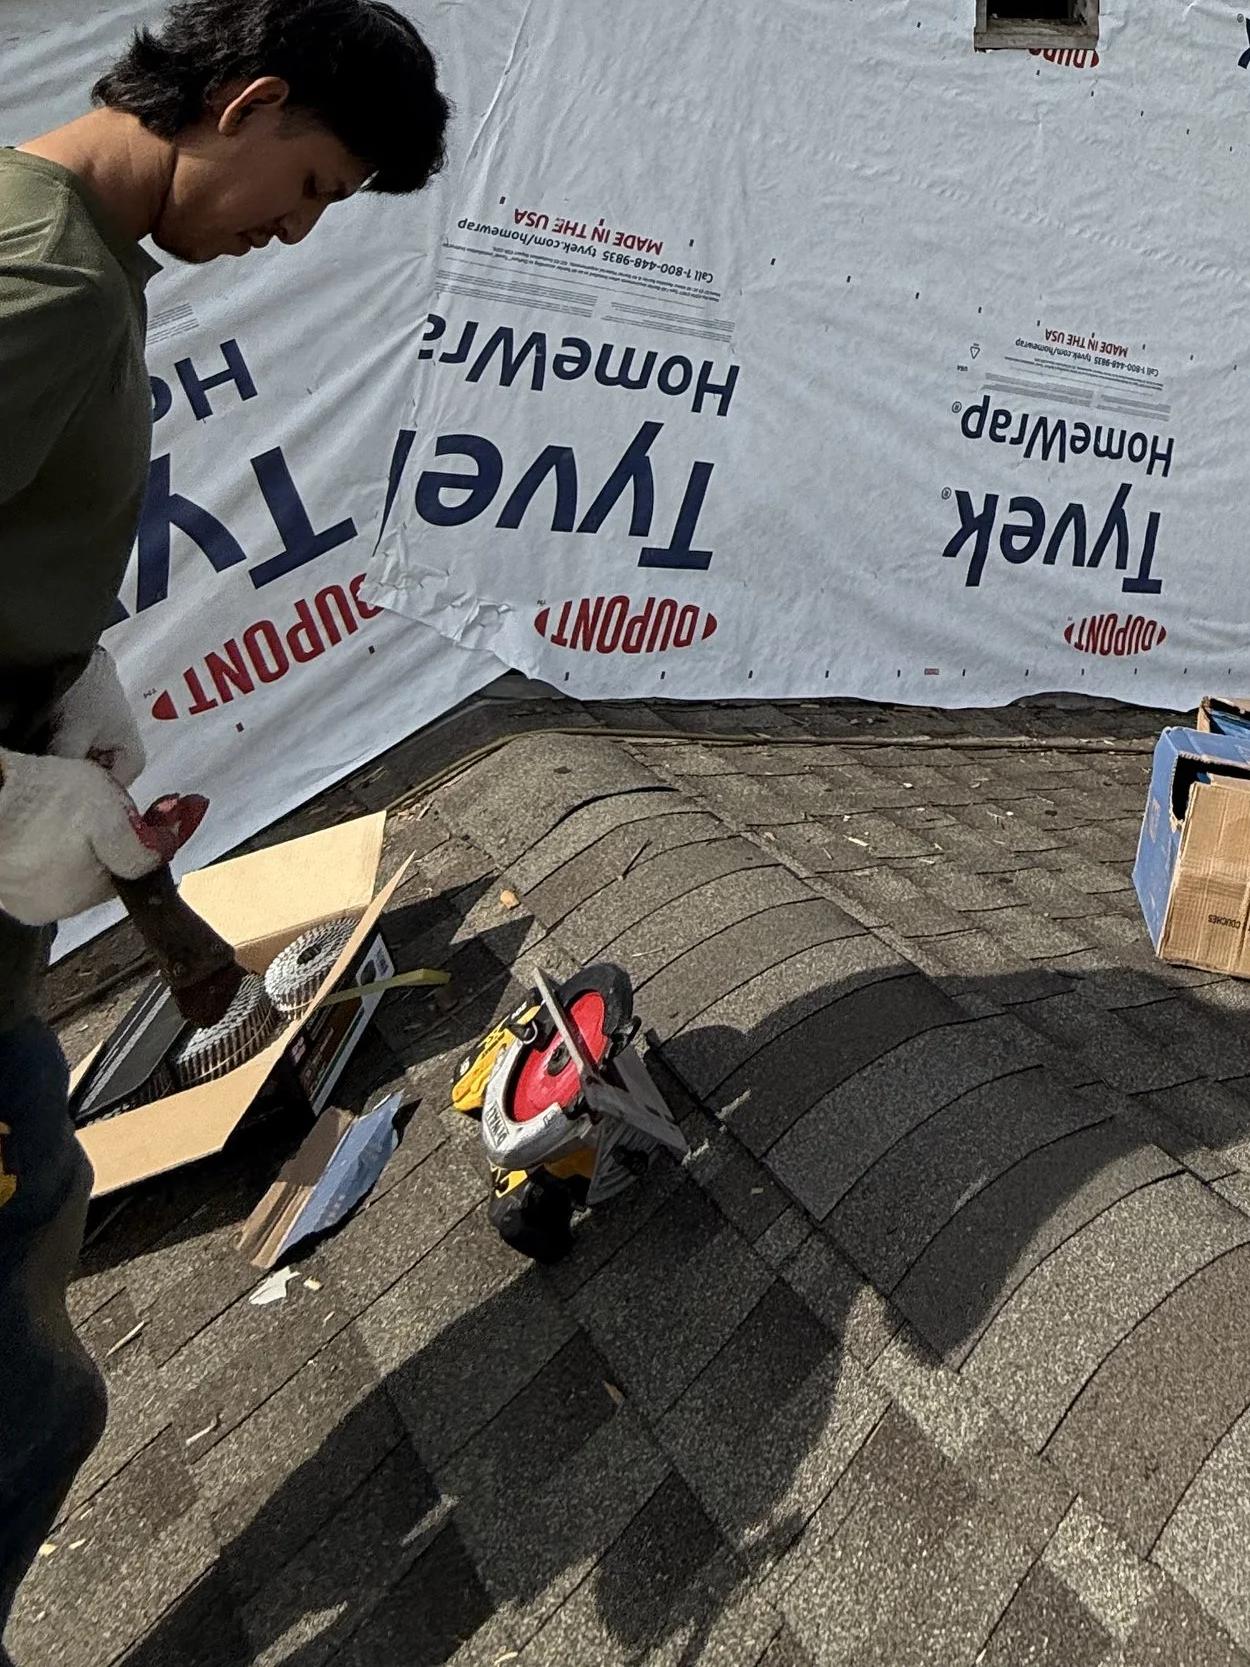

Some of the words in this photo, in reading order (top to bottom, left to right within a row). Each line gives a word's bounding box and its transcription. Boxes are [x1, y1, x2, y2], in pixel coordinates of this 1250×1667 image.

[514, 208, 550, 230] USA
[552, 216, 587, 240] THE
[457, 218, 597, 258] tyvek.com/homewrap
[591, 223, 611, 244] IN
[613, 231, 664, 256] MADE
[602, 250, 693, 280] 1-800-448-9835
[693, 269, 714, 284] Call
[1045, 328, 1065, 345] USA
[1066, 333, 1086, 349] THE
[1087, 337, 1099, 351] IN
[1099, 342, 1129, 358] MADE
[1147, 366, 1160, 377] Call
[960, 394, 1175, 478] HomeWrap
[941, 482, 1163, 595] Tyvek
[551, 594, 700, 654] DUPONT
[1073, 612, 1158, 657] DUPONT
